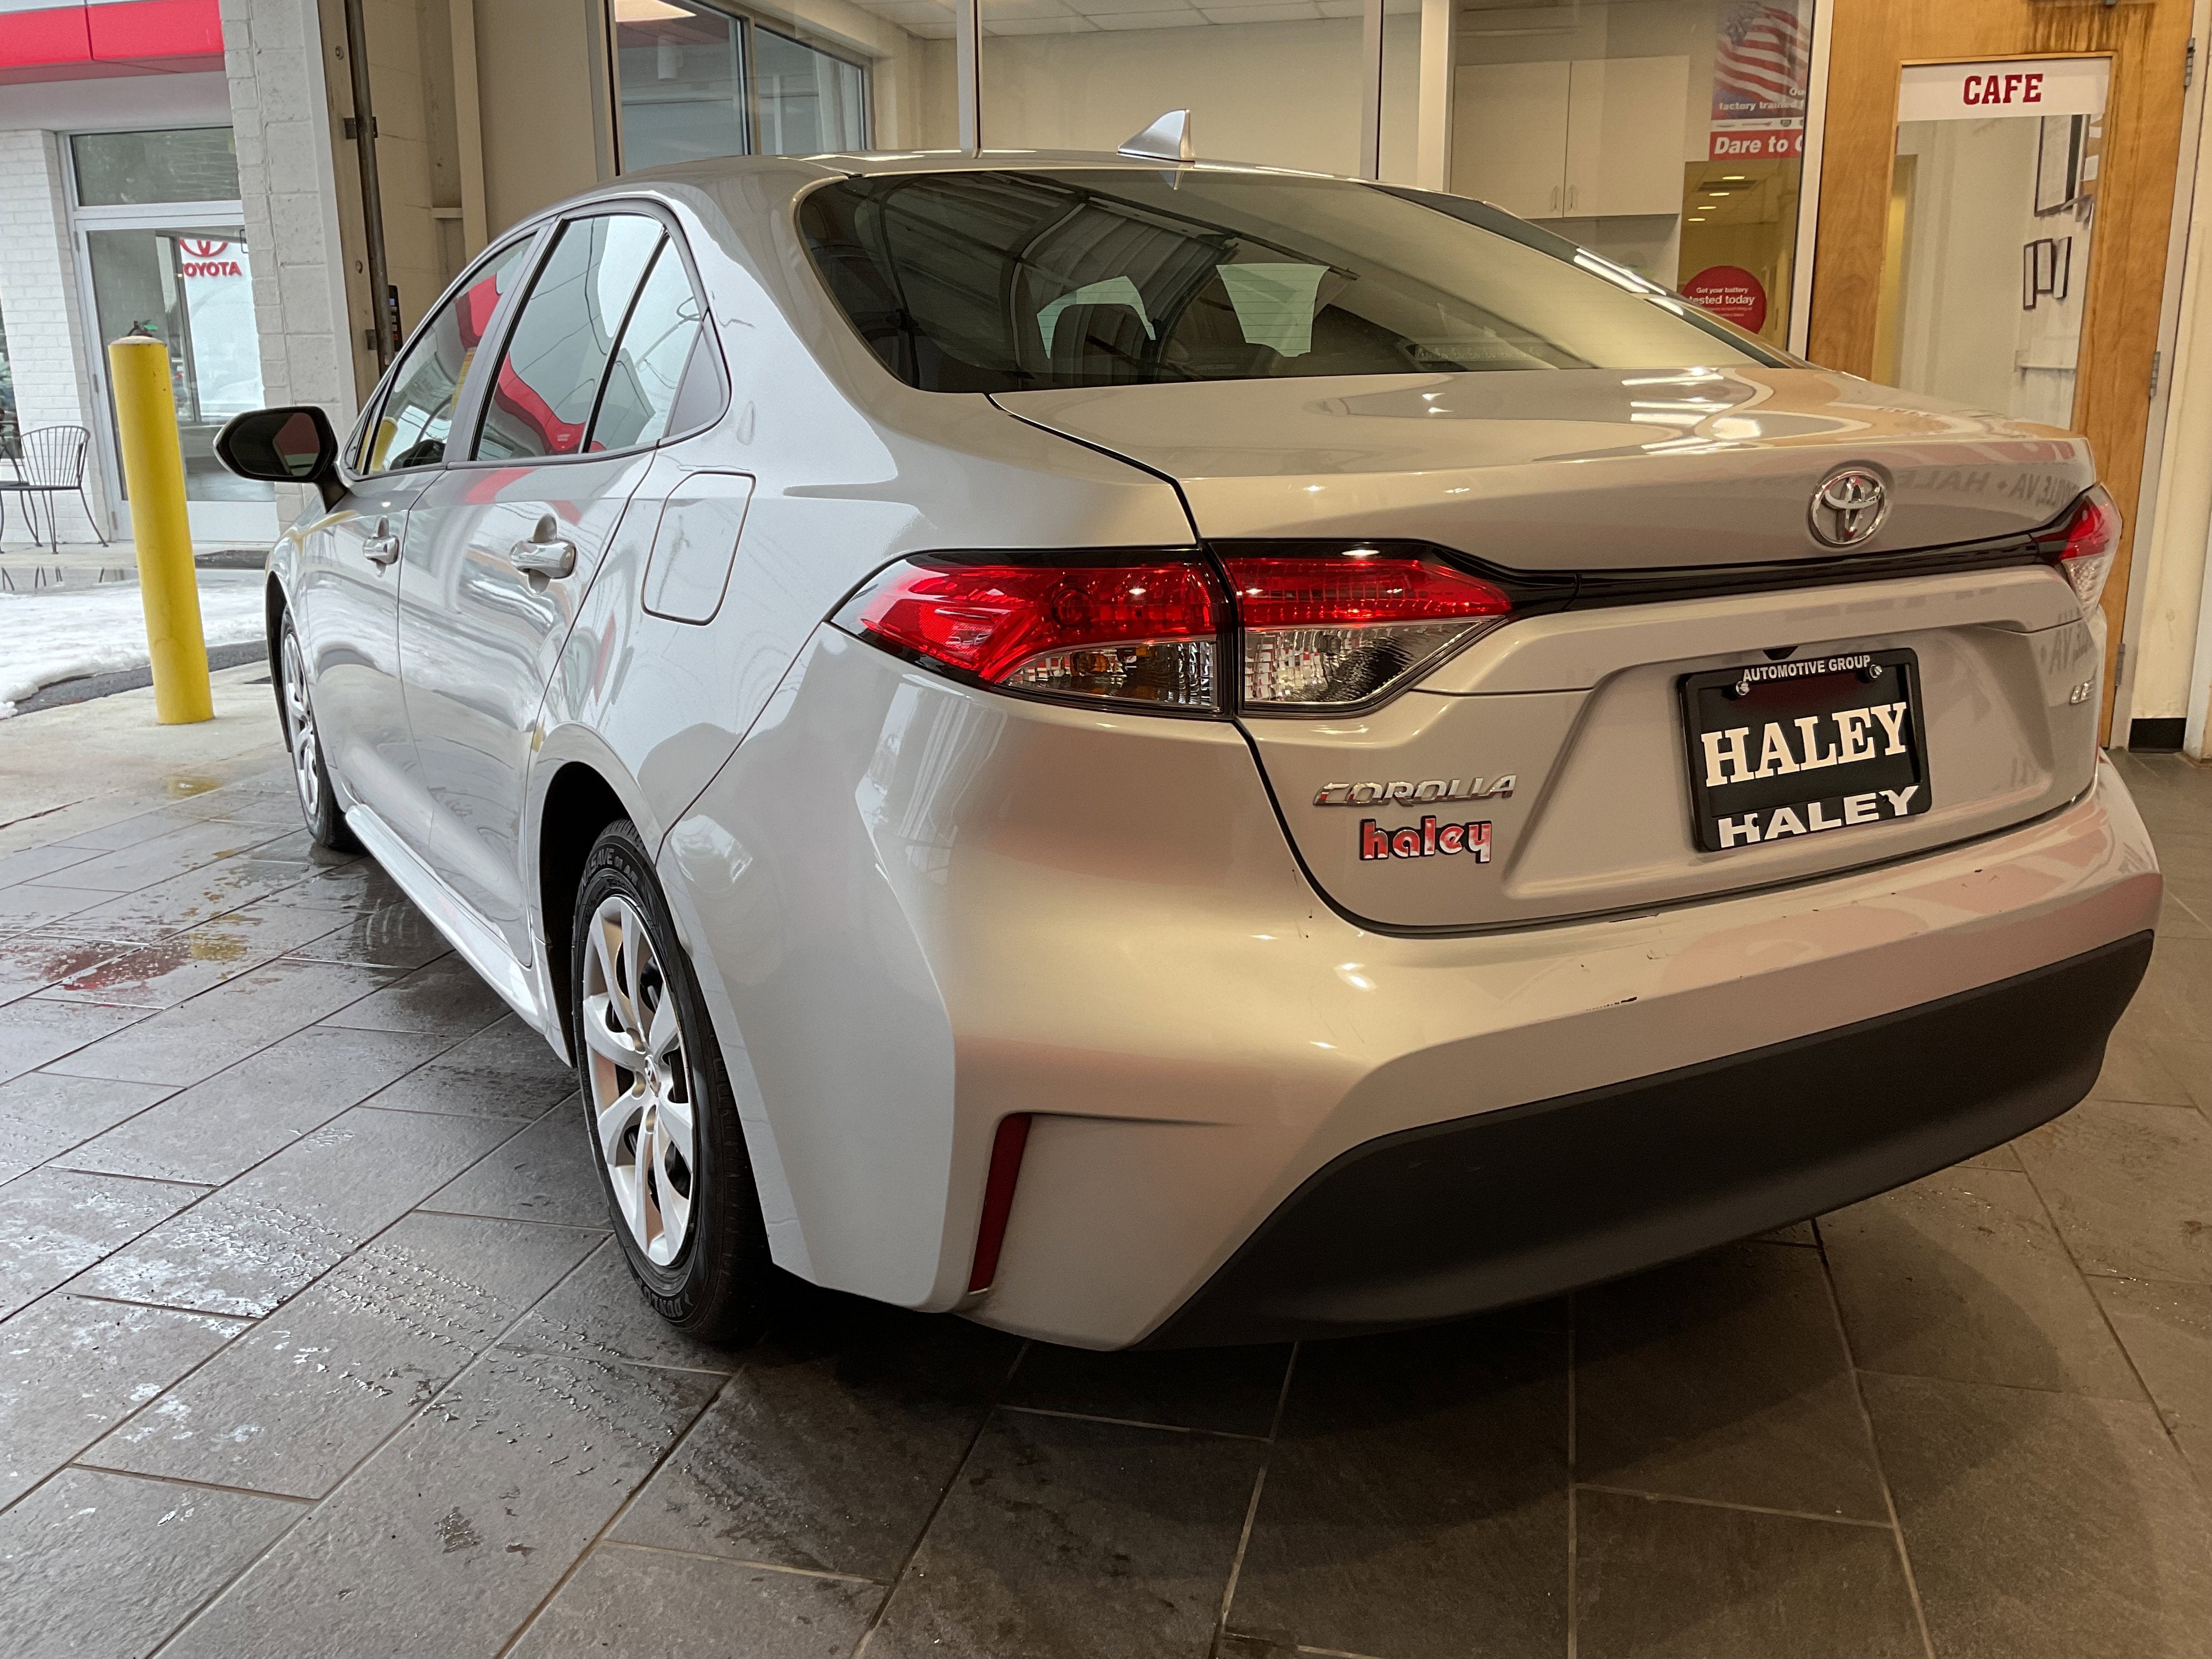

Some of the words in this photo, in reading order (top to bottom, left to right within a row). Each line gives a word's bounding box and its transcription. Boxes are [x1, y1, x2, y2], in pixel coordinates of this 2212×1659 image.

[1963, 74, 2043, 105] CAFE
[1719, 102, 1756, 111] factory
[1714, 137, 1762, 154] Dare
[1768, 136, 1788, 153] to
[182, 261, 242, 276] OYOTA
[1725, 295, 1755, 306] today
[1742, 660, 1825, 682] AUTOMOTIVE
[1828, 654, 1870, 672] GROUP
[1701, 702, 1906, 787] HALEY
[1313, 775, 1516, 807] COROLLA
[1718, 785, 1919, 848] HALEY
[1361, 816, 1492, 863] haley
